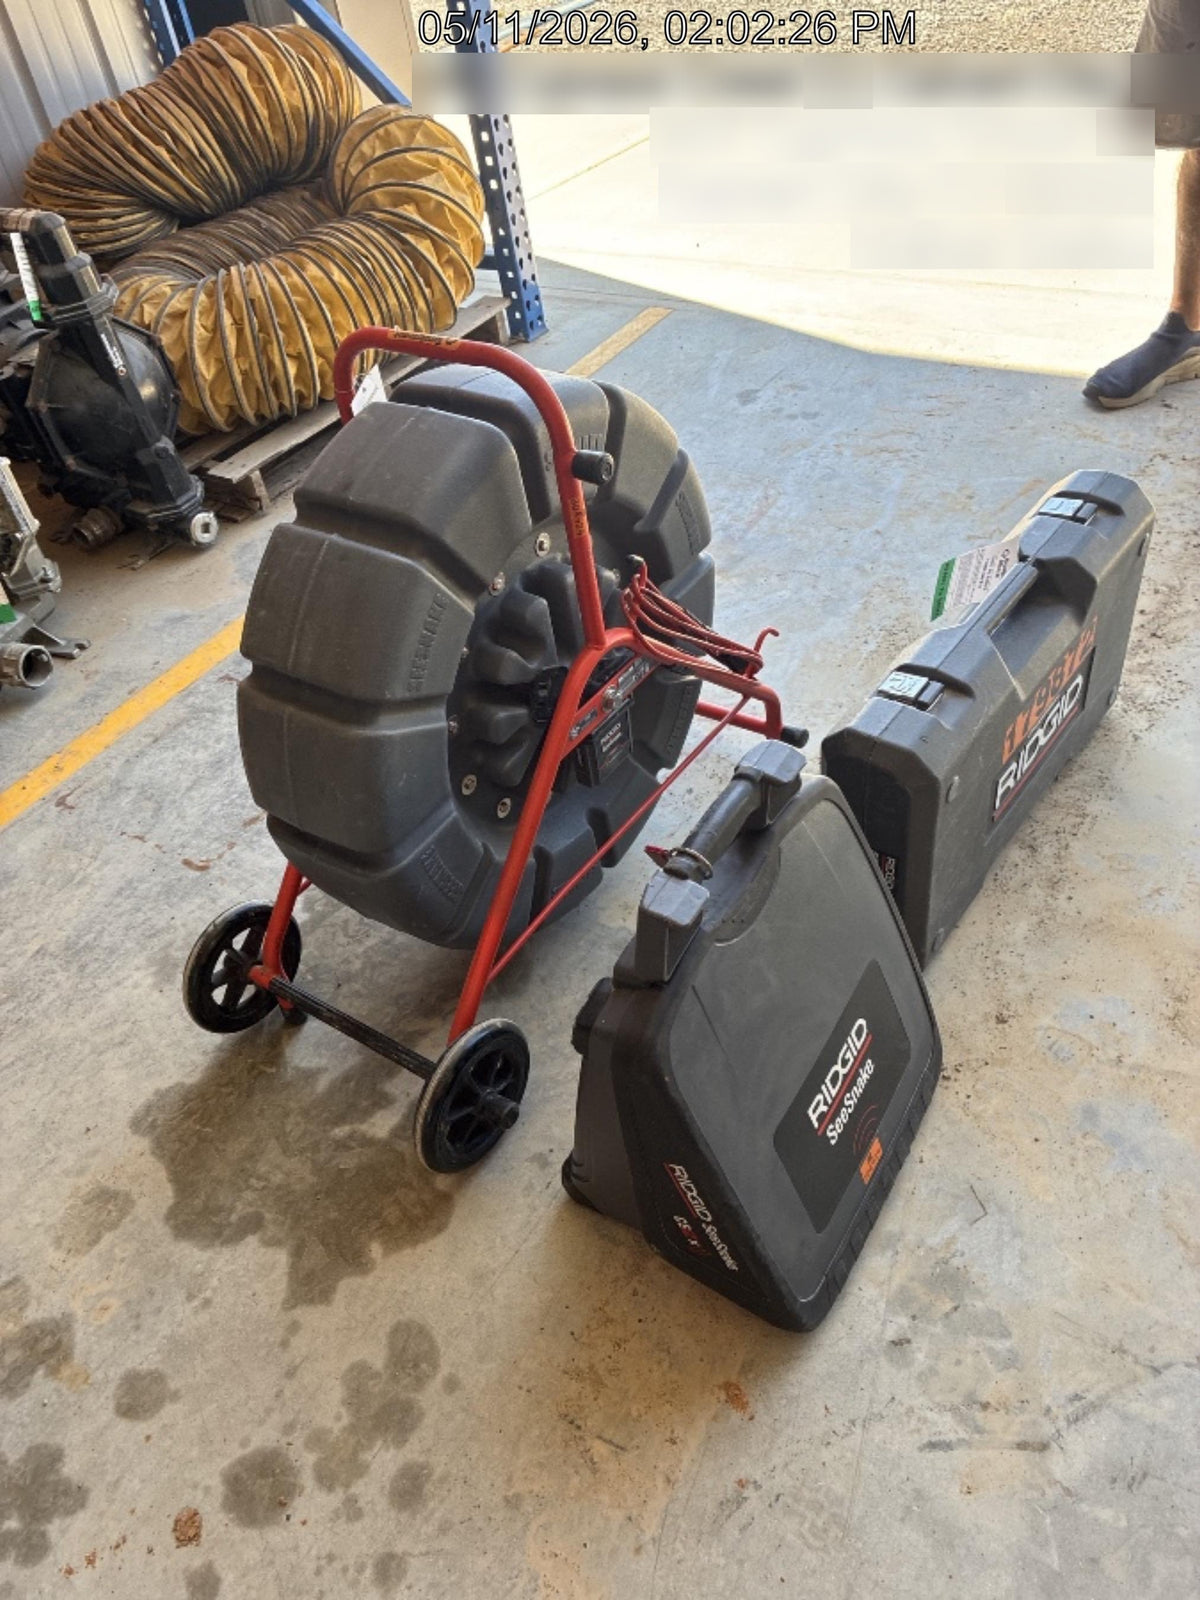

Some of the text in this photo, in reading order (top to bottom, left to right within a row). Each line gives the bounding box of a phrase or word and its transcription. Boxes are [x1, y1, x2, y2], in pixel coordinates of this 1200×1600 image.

[994, 674, 1083, 810] RIDGID
[807, 1018, 868, 1129] RIDGID
[826, 1059, 875, 1145] SeeSnake
[668, 1164, 712, 1222] RIDGID
